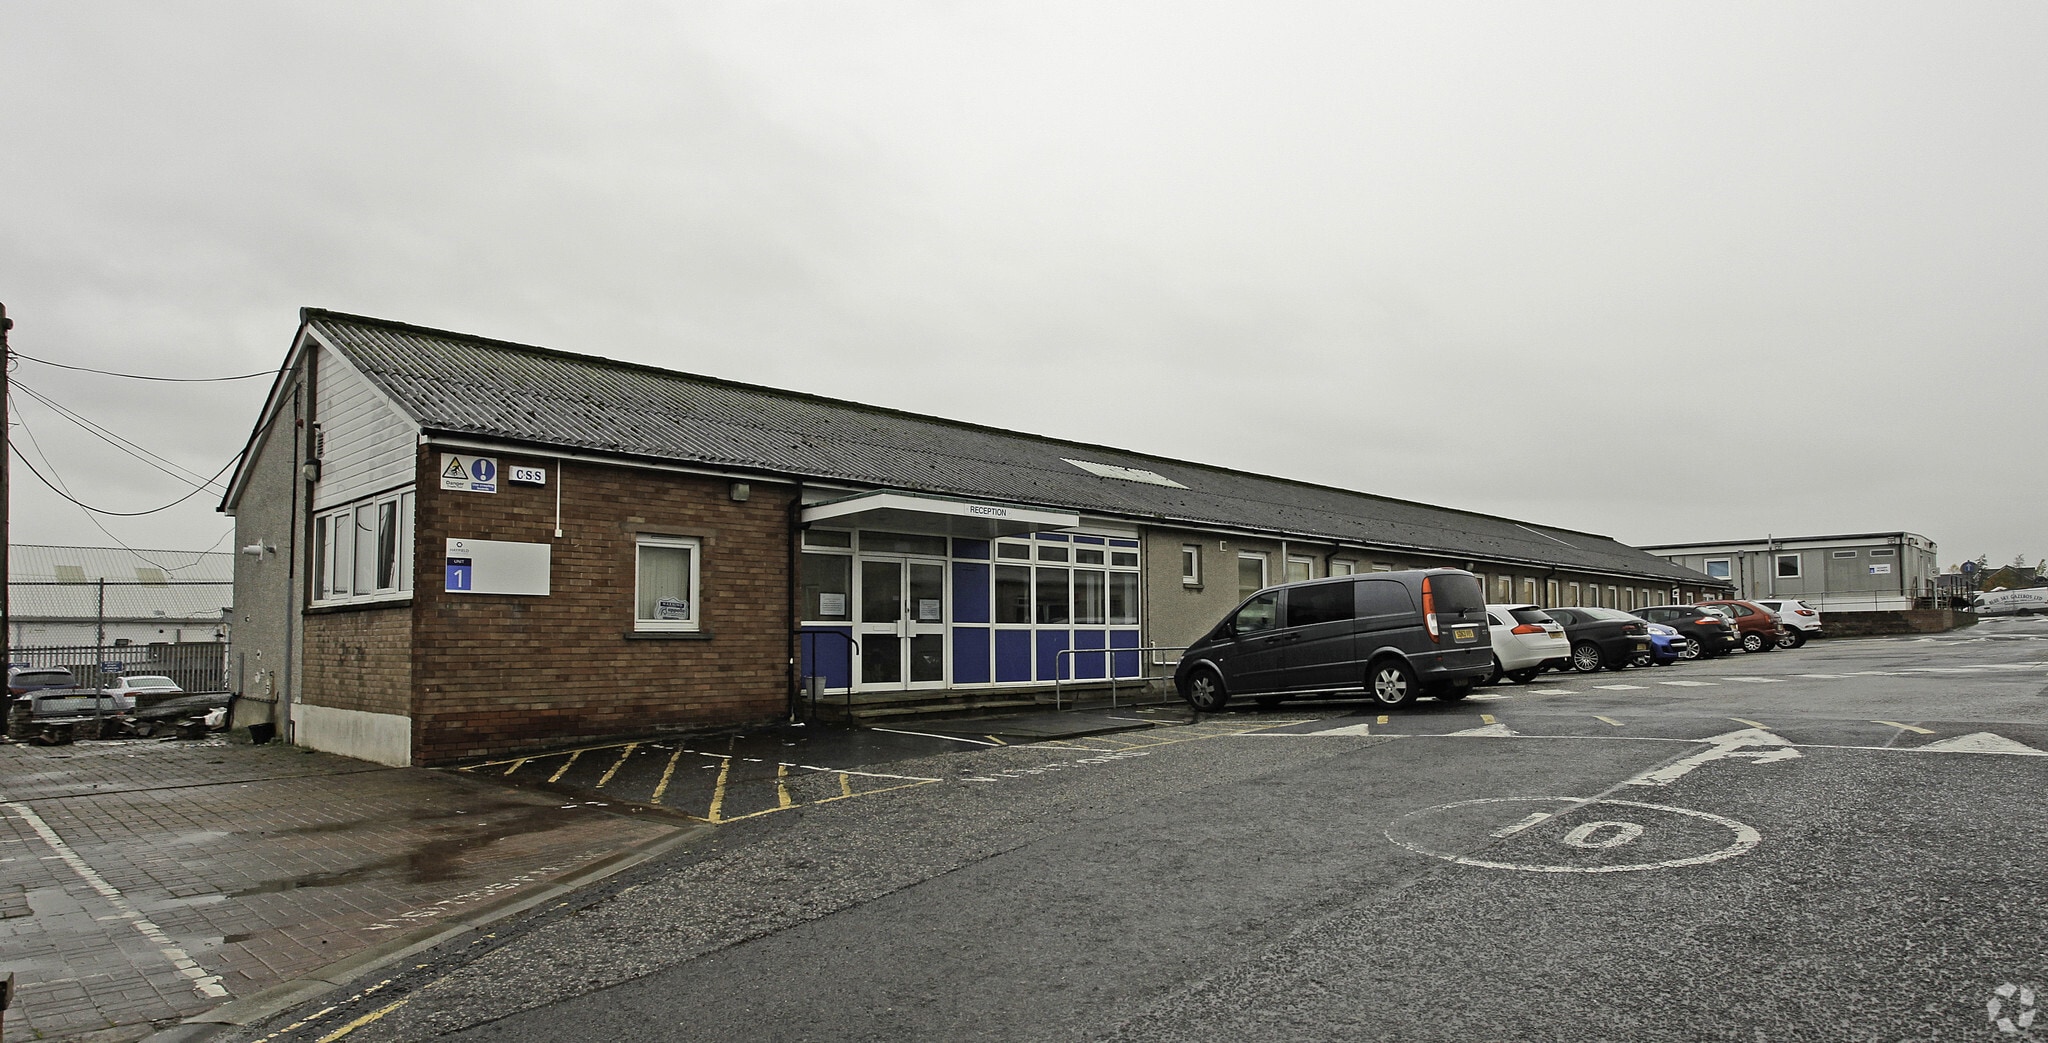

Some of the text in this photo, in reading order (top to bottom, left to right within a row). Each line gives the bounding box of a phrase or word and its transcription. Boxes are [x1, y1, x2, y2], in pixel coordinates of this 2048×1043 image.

[970, 505, 1007, 516] RECEPTION
[453, 569, 463, 588] 1
[1490, 812, 1644, 849] 10
